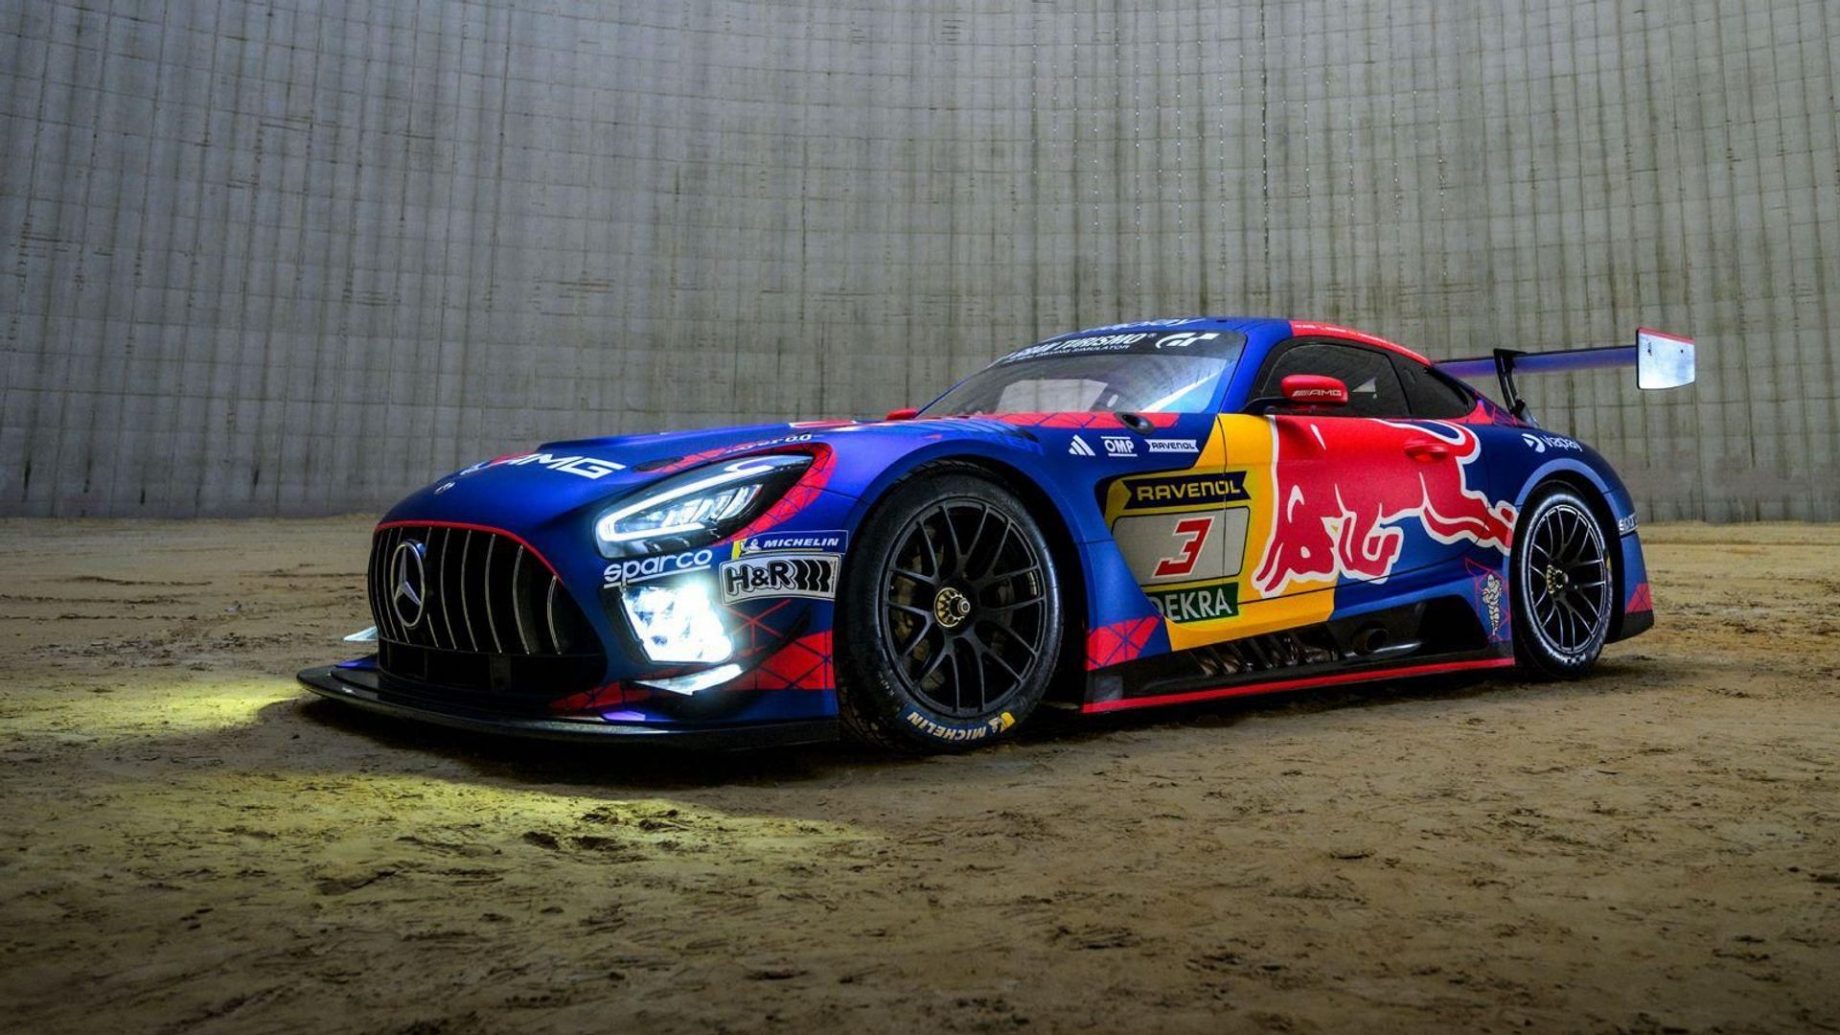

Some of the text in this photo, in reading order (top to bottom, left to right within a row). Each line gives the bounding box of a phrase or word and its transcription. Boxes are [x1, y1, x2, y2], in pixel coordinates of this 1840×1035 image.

[1104, 438, 1135, 454] OMP
[1151, 441, 1195, 450] RAVENOL
[1136, 479, 1242, 501] RAVENOL
[763, 537, 840, 548] MICHELIN
[1152, 516, 1216, 579] 3
[603, 549, 713, 586] sparco
[727, 560, 798, 596] H&R
[906, 711, 987, 741] MICHELIN
